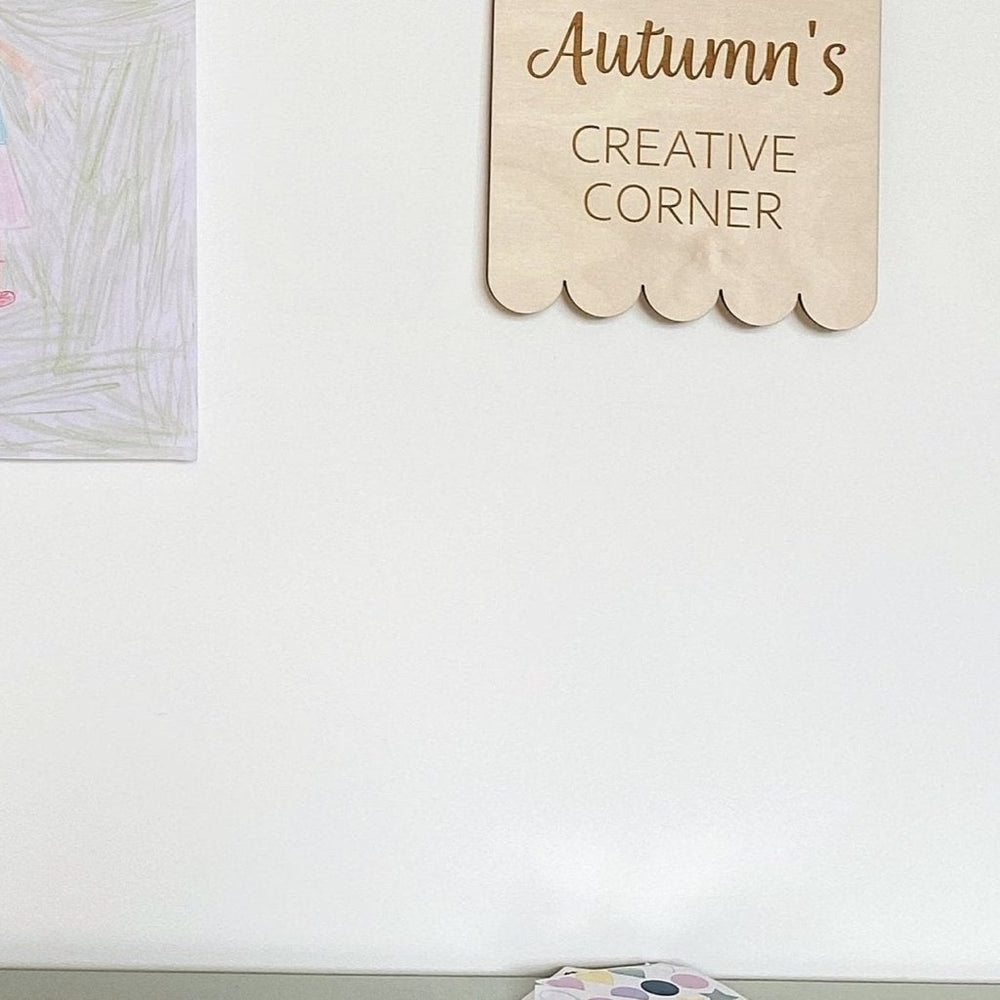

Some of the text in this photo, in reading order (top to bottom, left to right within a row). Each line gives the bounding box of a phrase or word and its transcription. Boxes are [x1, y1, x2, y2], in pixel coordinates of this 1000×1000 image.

[526, 11, 847, 96] Autumn's
[571, 124, 797, 174] CREATIVE
[583, 182, 783, 230] CORNER
